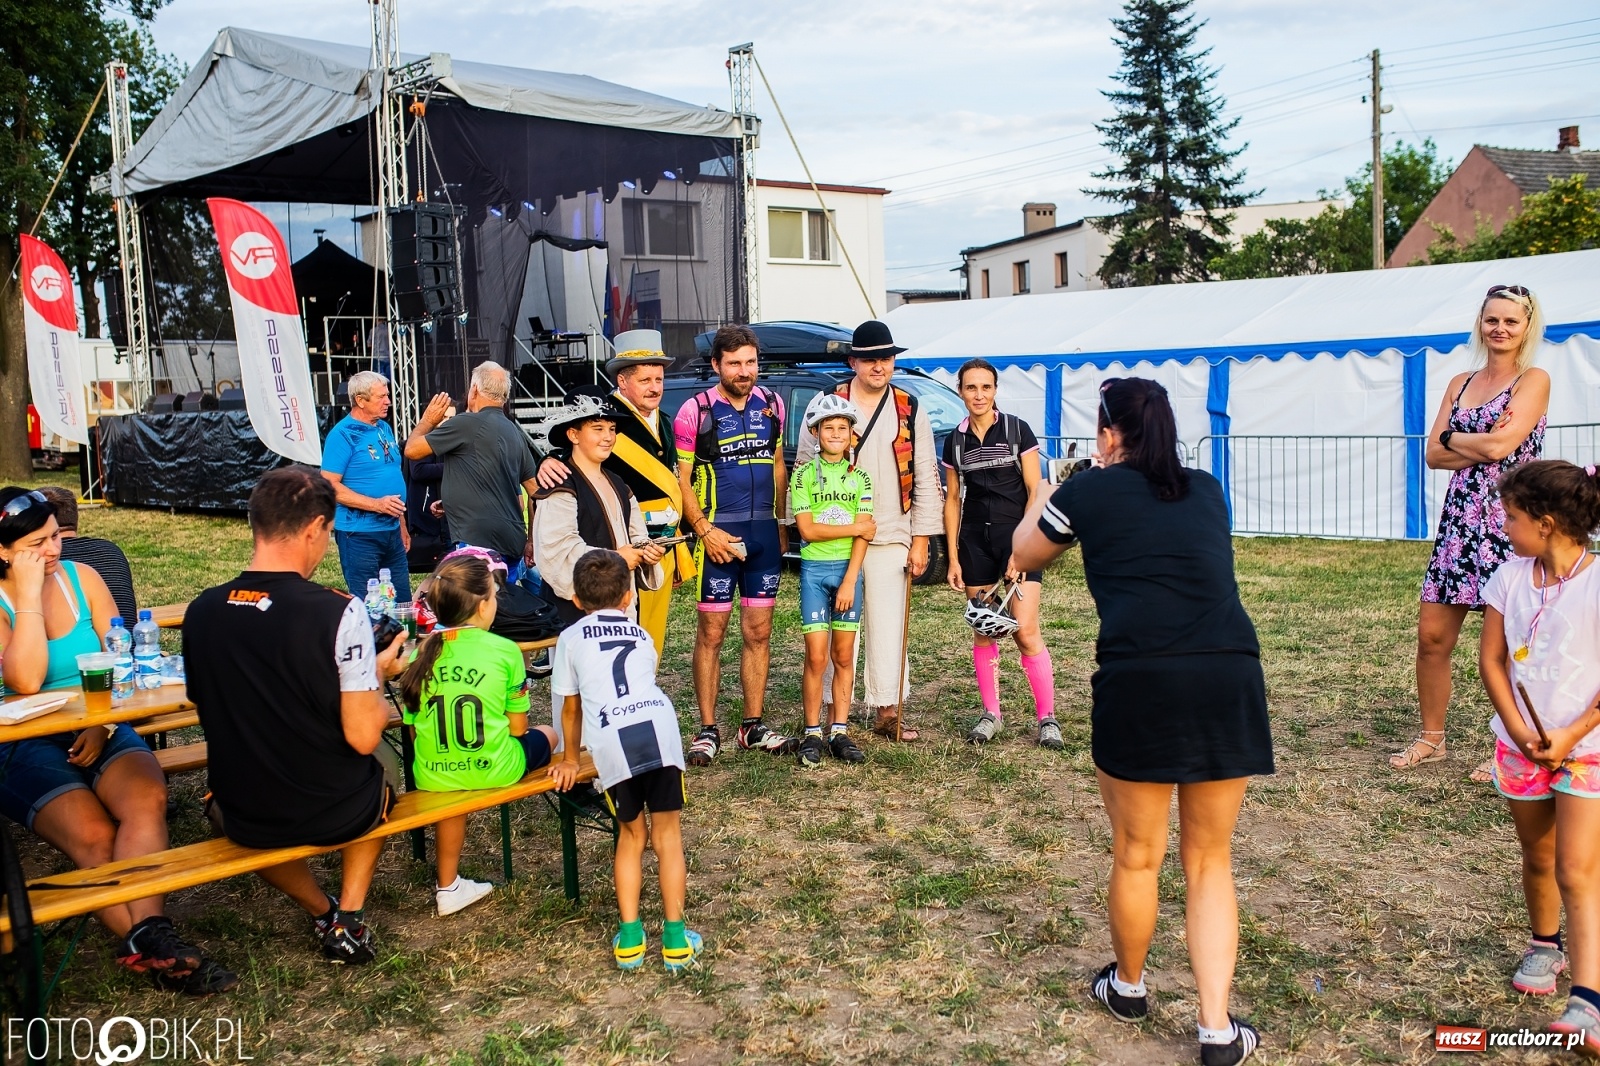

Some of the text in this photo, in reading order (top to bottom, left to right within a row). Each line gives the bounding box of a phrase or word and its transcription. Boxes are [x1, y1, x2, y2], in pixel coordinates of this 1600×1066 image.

[599, 639, 637, 699] 7
[425, 694, 485, 754] 10
[612, 699, 665, 716] Cygames
[425, 757, 471, 772] unicef
